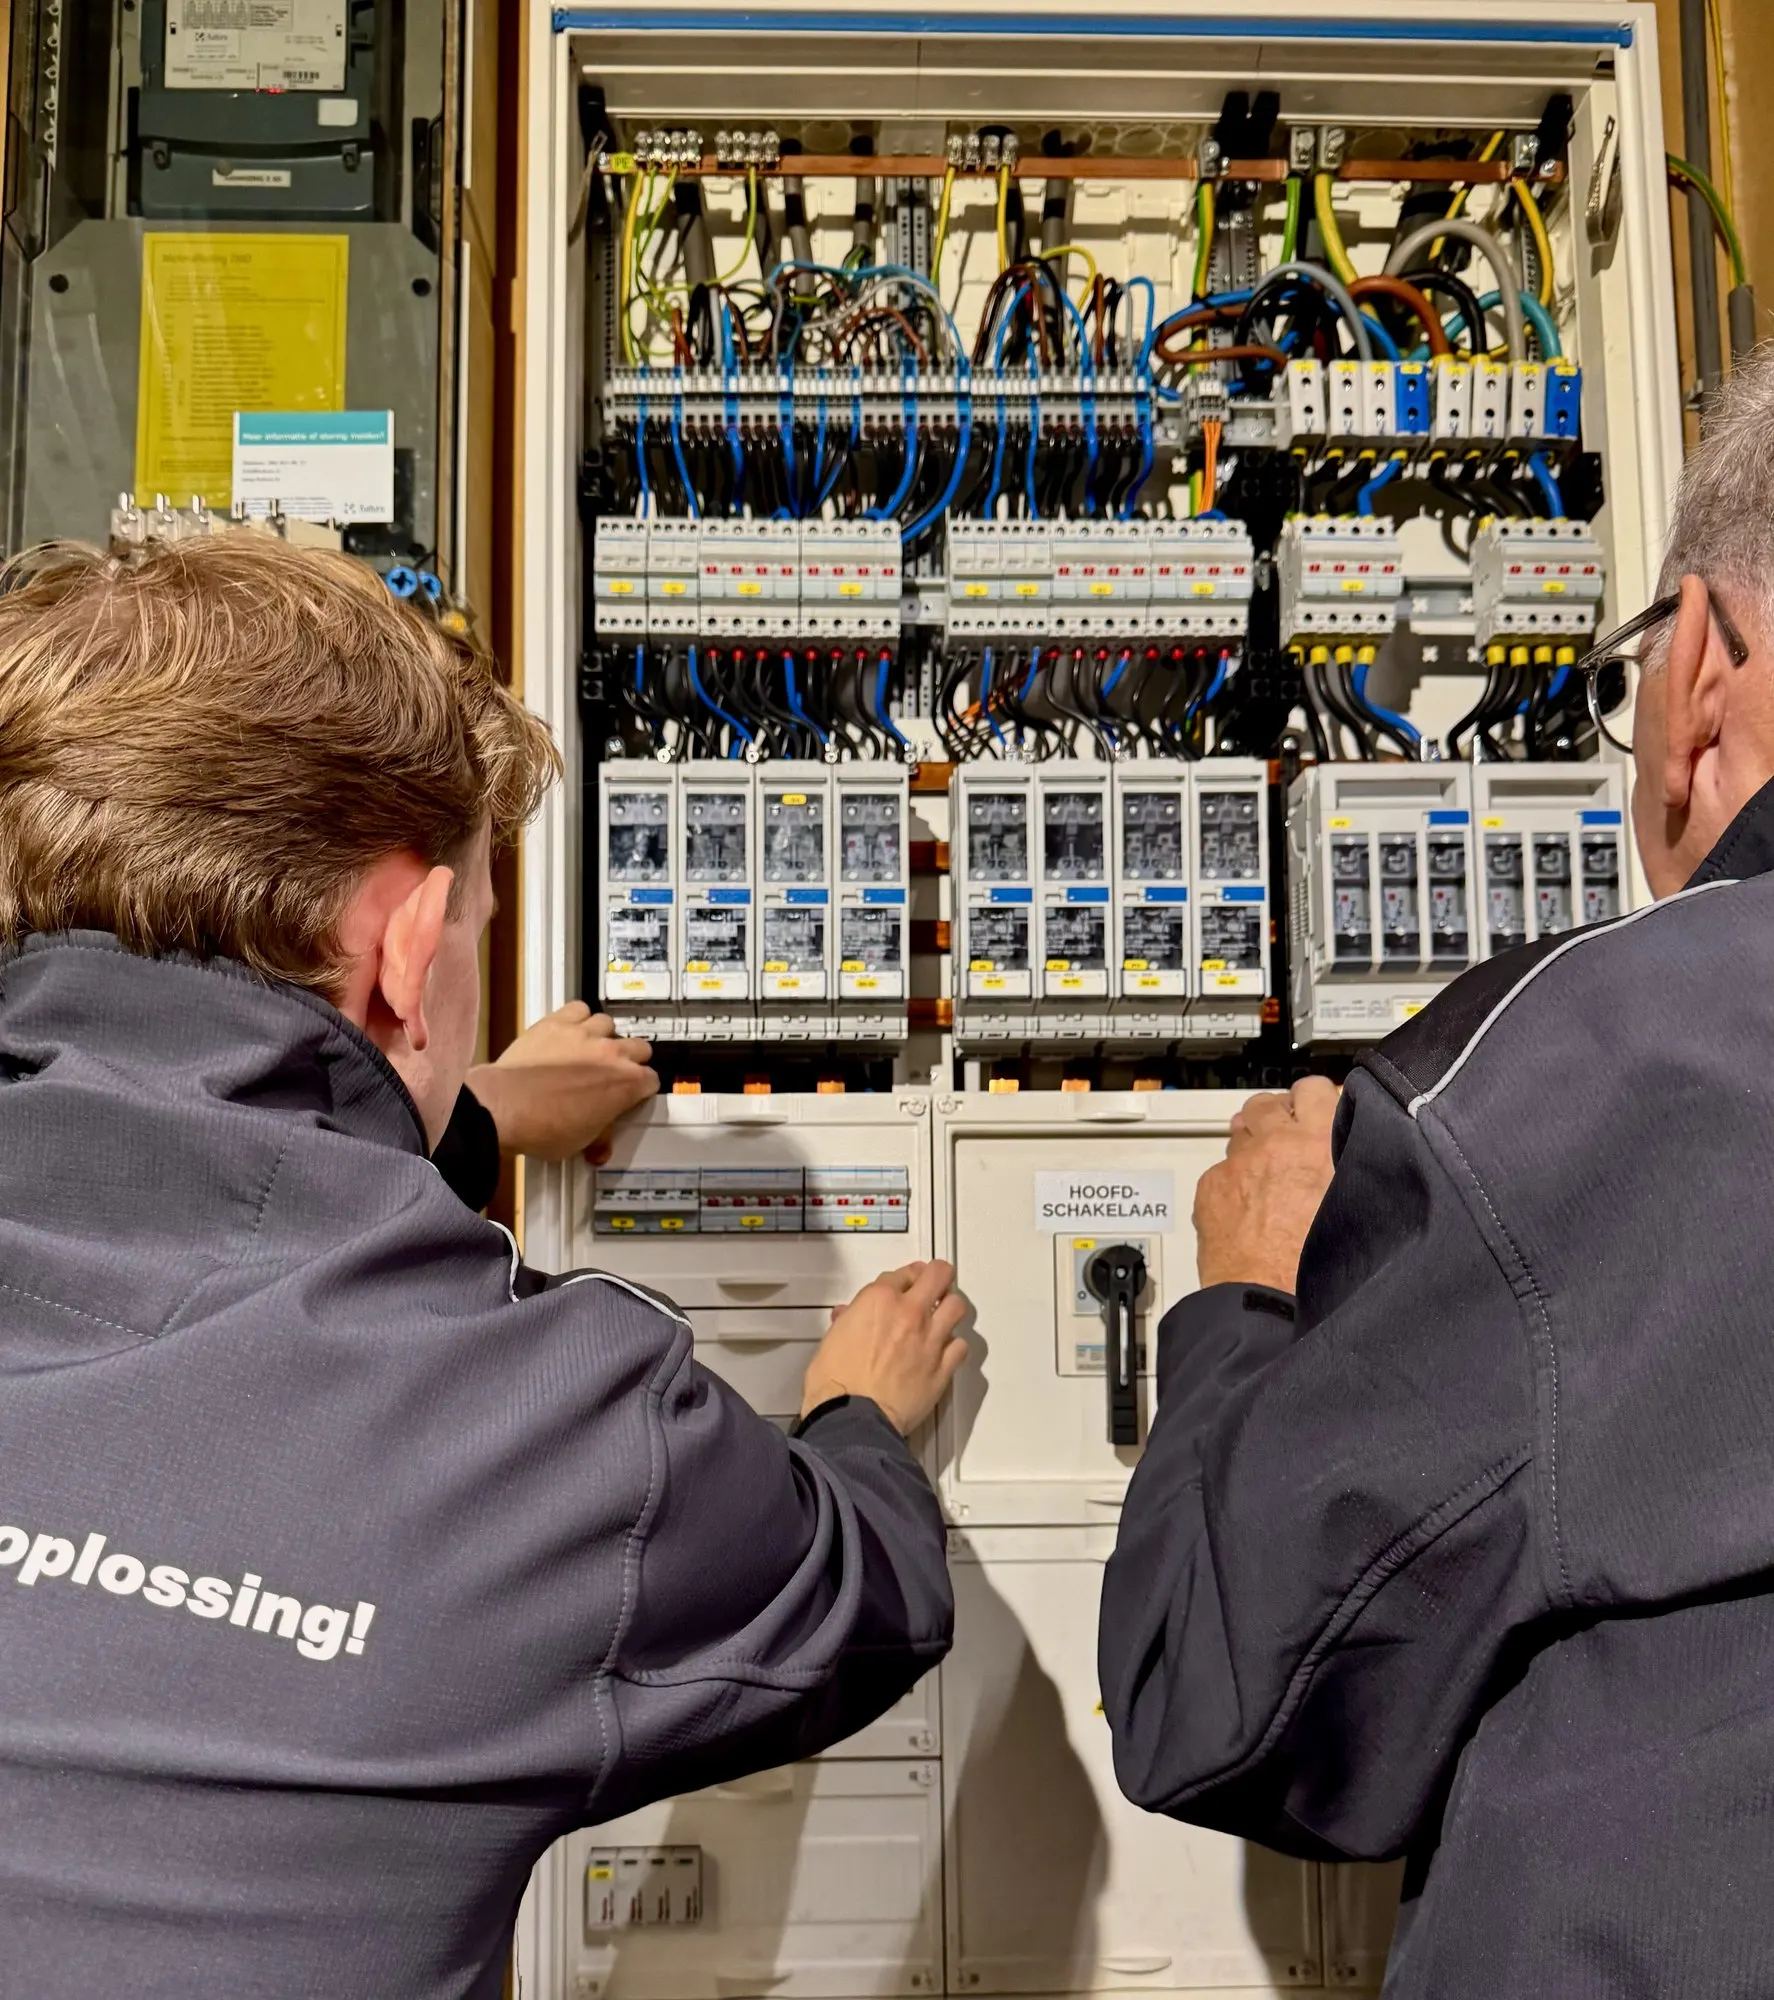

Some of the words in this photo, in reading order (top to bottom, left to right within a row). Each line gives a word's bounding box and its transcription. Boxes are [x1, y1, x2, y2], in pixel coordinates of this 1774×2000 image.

[1069, 1185, 1139, 1199] HOOFD-
[1042, 1203, 1168, 1217] SCHAKELAAR
[0, 1526, 375, 1661] oplossing!
